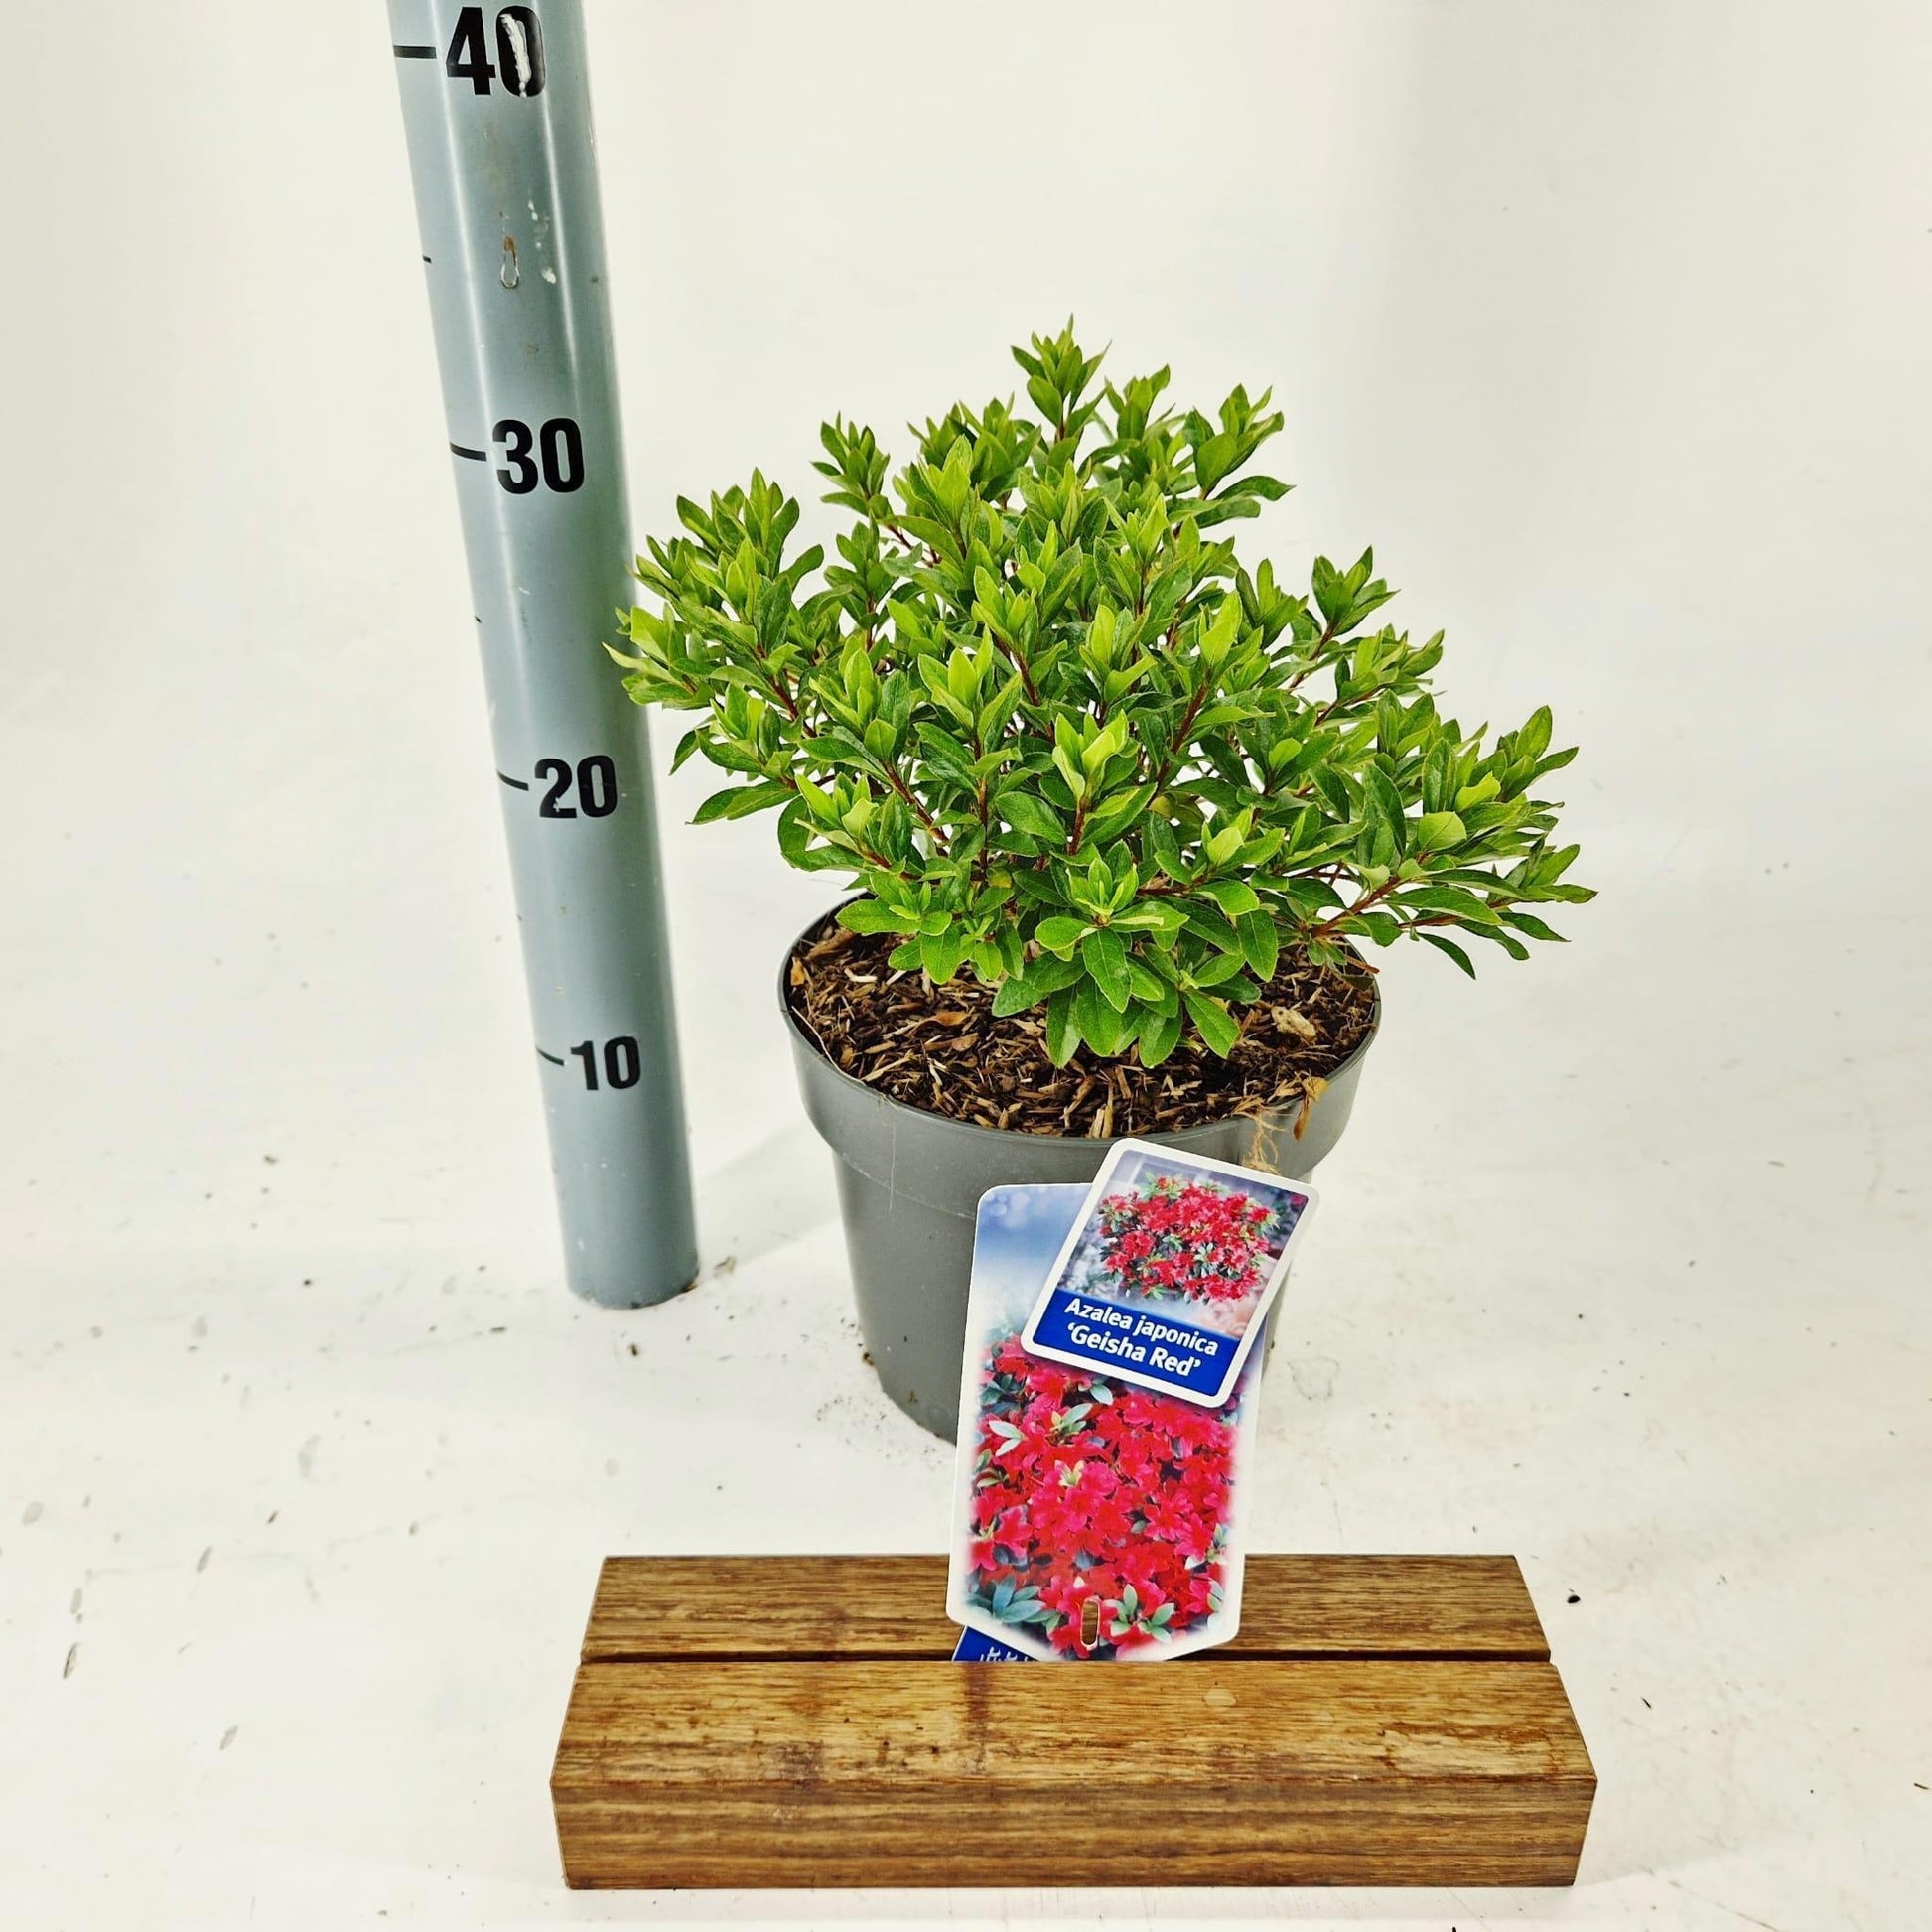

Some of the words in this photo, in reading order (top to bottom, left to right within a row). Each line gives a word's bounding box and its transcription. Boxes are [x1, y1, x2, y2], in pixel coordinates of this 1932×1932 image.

[446, 5, 545, 98] 40
[492, 417, 585, 494] 30
[534, 755, 618, 819] 20
[570, 1035, 641, 1091] 10
[1063, 1297, 1133, 1331] Azalea
[1132, 1315, 1219, 1357] japonica
[1067, 1321, 1147, 1363] ‘Geisha
[1149, 1346, 1201, 1377] Red’
